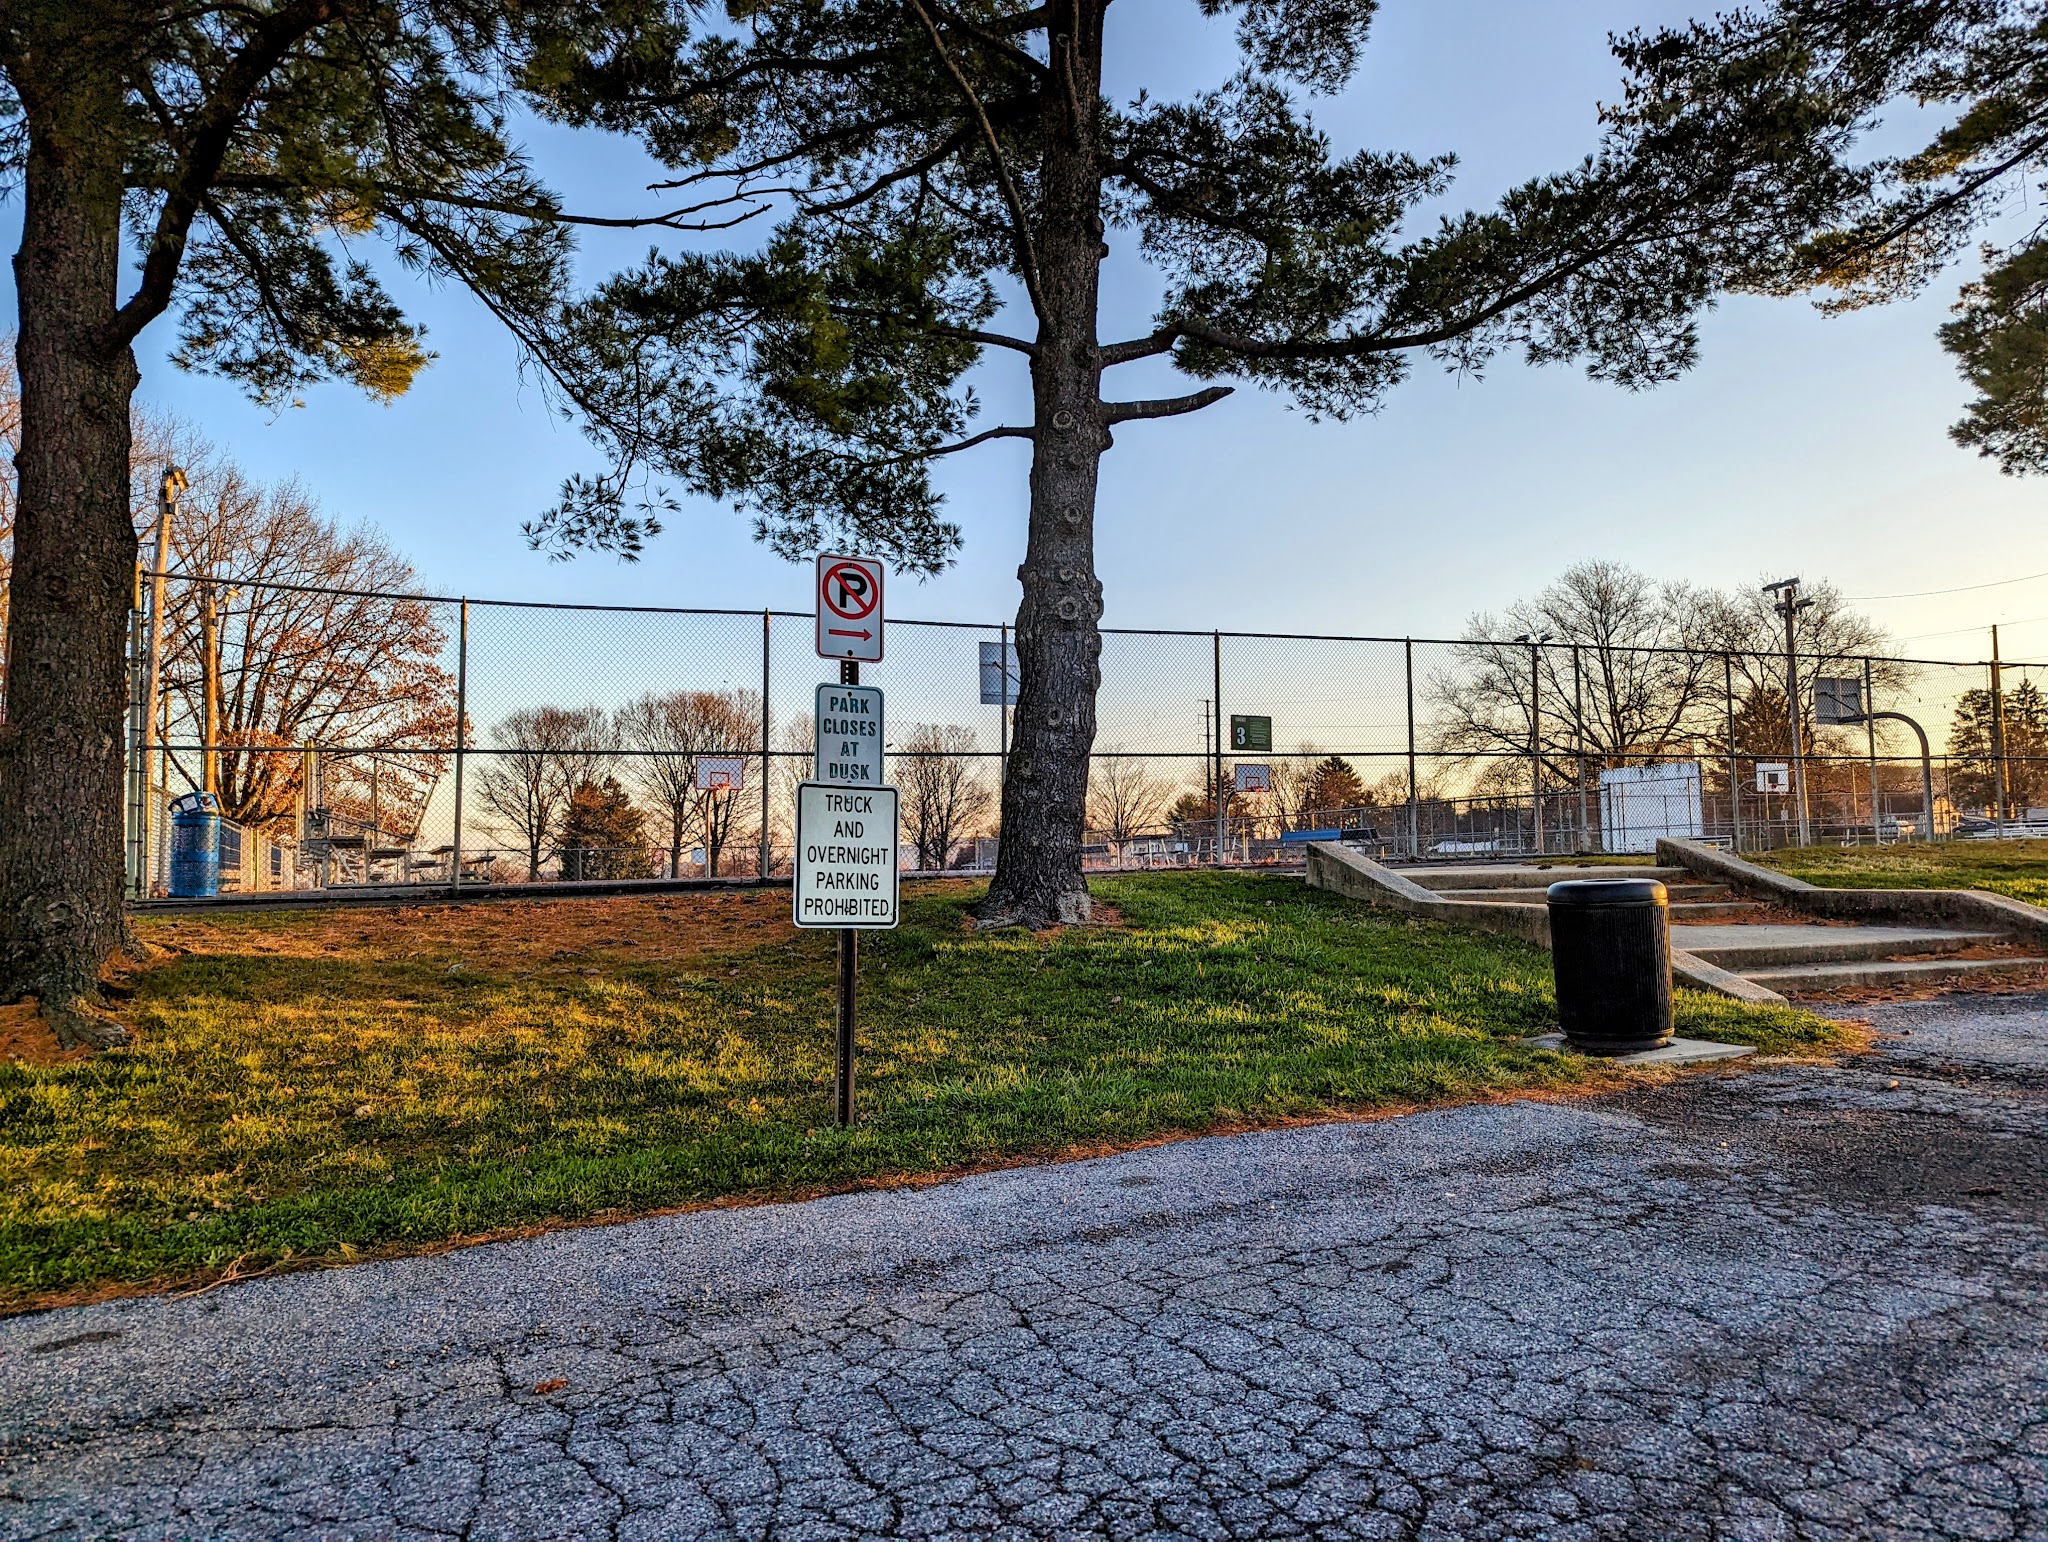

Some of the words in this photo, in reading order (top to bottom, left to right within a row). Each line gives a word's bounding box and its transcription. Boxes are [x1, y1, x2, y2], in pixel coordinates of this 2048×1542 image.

[830, 696, 870, 714] PARK
[823, 718, 876, 737] CLOSES
[1236, 726, 1246, 745] 3
[840, 741, 860, 757] AT
[829, 762, 870, 780] DUSK
[825, 794, 872, 814] TRUCK
[833, 820, 864, 838] AND
[807, 845, 889, 865] OVERNIGHT
[816, 871, 879, 891] PARKING
[804, 897, 889, 917] PROHIBITED
